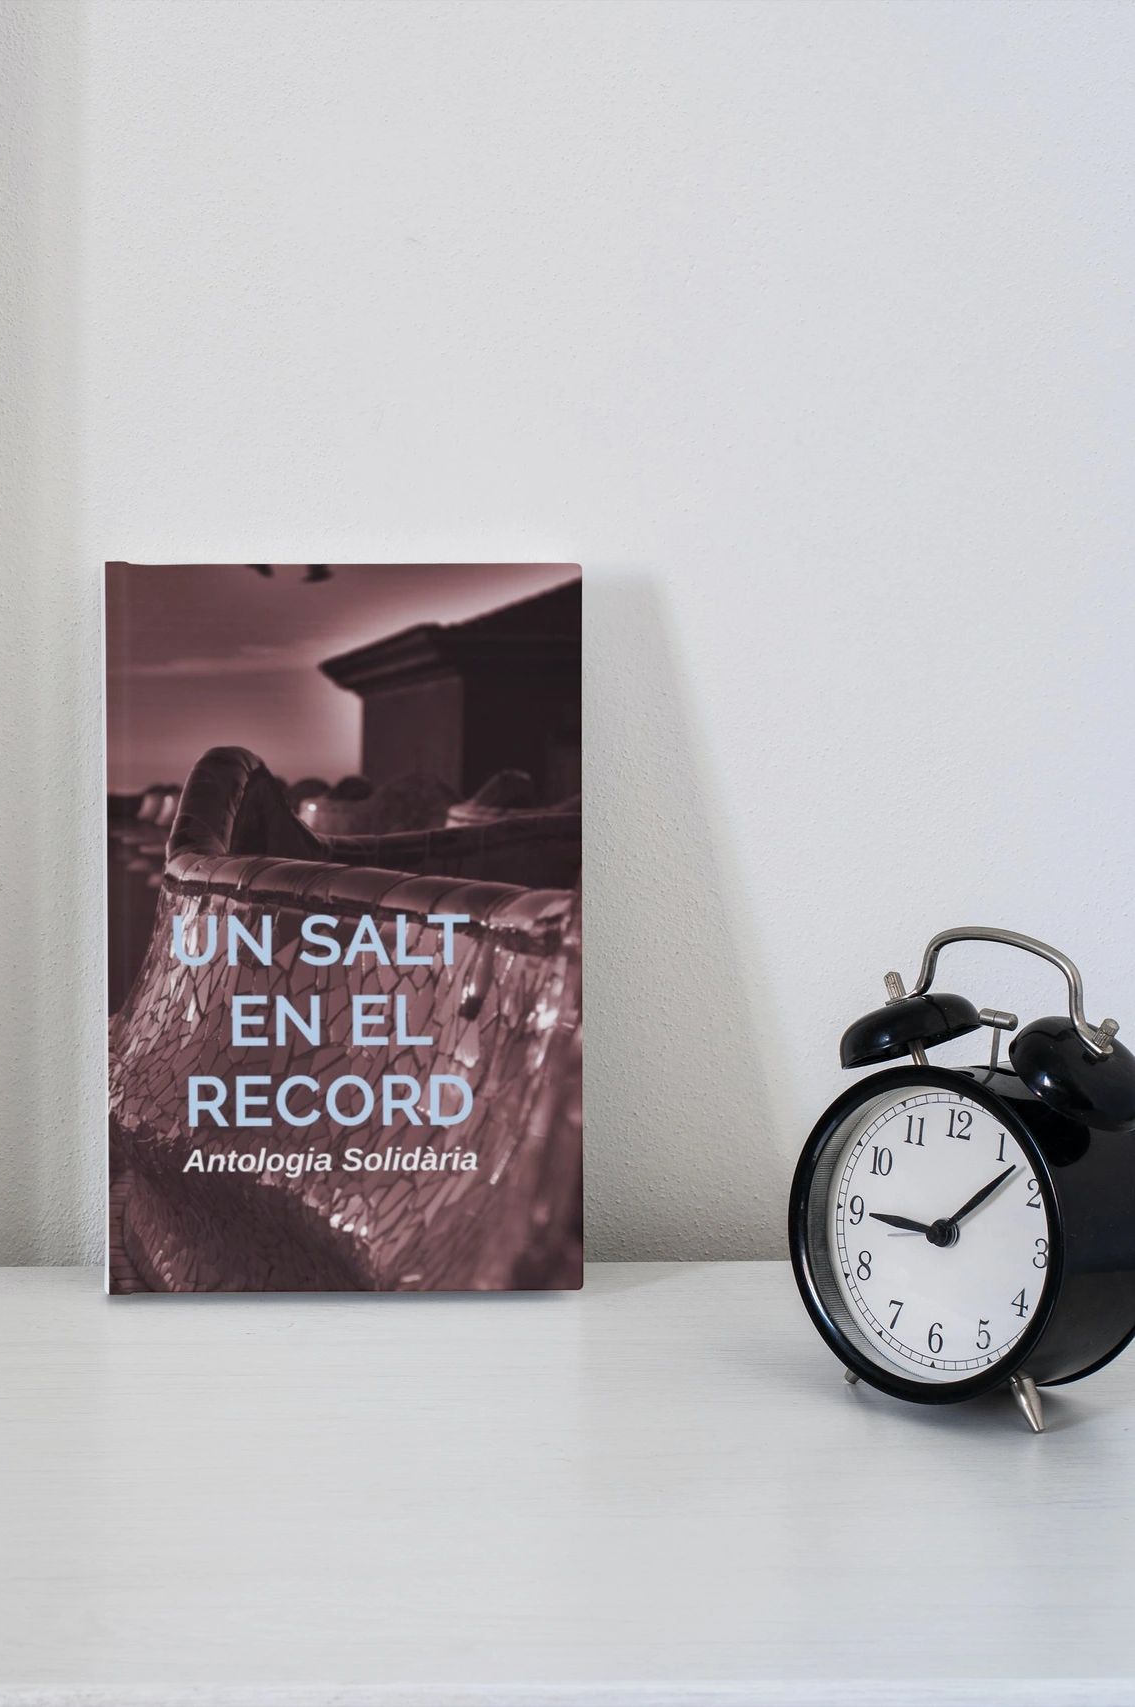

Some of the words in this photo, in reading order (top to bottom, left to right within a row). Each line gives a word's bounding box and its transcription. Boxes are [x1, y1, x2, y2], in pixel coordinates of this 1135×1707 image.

[172, 914, 272, 966] UN
[300, 913, 471, 966] SALT
[231, 994, 321, 1047] EN
[352, 994, 434, 1046] EL
[187, 1073, 474, 1128] RECORD
[903, 1114, 925, 1147] 11
[945, 1108, 974, 1141] 12
[182, 1147, 333, 1178] Antologia
[341, 1146, 479, 1172] Solidària
[869, 1145, 893, 1176] 10
[995, 1132, 1006, 1162] 1
[1025, 1178, 1042, 1209] 2
[849, 1194, 865, 1225] 9
[856, 1250, 872, 1281] 8
[1032, 1238, 1048, 1269] 3
[888, 1299, 904, 1330] 7
[1010, 1287, 1029, 1318] 4
[927, 1322, 943, 1354] 6
[976, 1319, 992, 1350] 5
